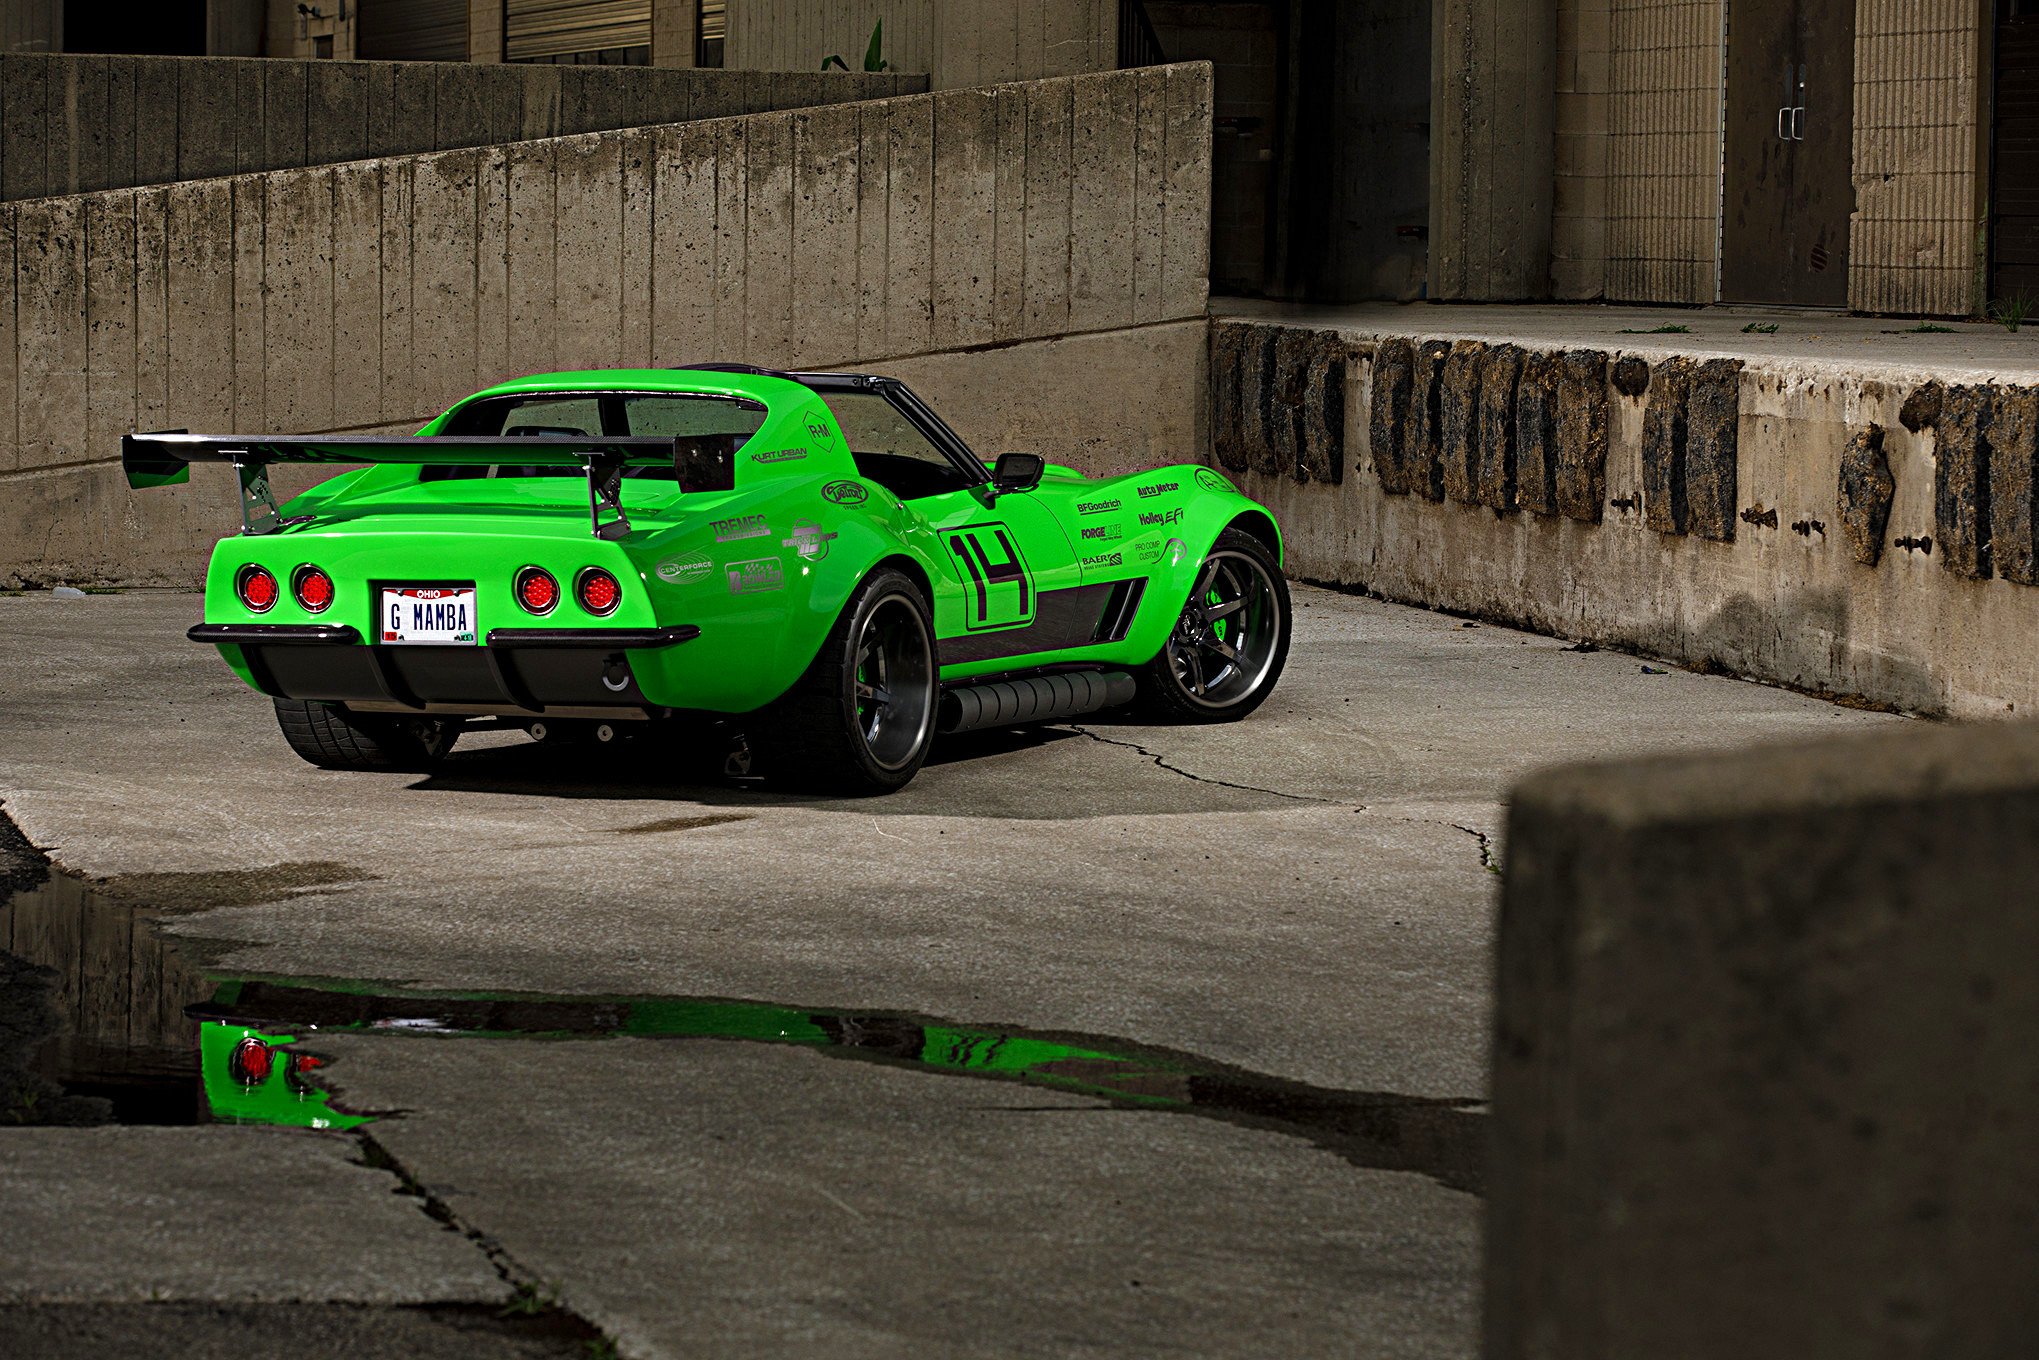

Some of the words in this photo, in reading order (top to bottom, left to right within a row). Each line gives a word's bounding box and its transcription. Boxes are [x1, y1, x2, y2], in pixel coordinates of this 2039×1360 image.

[751, 451, 775, 461] KURT
[776, 447, 807, 458] URBAN
[1137, 486, 1156, 496] Auto
[1156, 482, 1179, 495] Meter
[1077, 499, 1121, 511] BFGoodrich
[709, 514, 767, 536] TREMEC
[1139, 512, 1164, 526] Holley
[1135, 543, 1145, 551] PRO
[1082, 555, 1108, 565] BAER
[1139, 550, 1159, 561] CUSTOM
[660, 561, 712, 573] CENTERFORCE
[742, 570, 782, 586] BOWLER
[950, 529, 1029, 622] 14
[417, 590, 440, 598] OHIO
[391, 603, 401, 630] G
[413, 603, 467, 630] MAMBA
